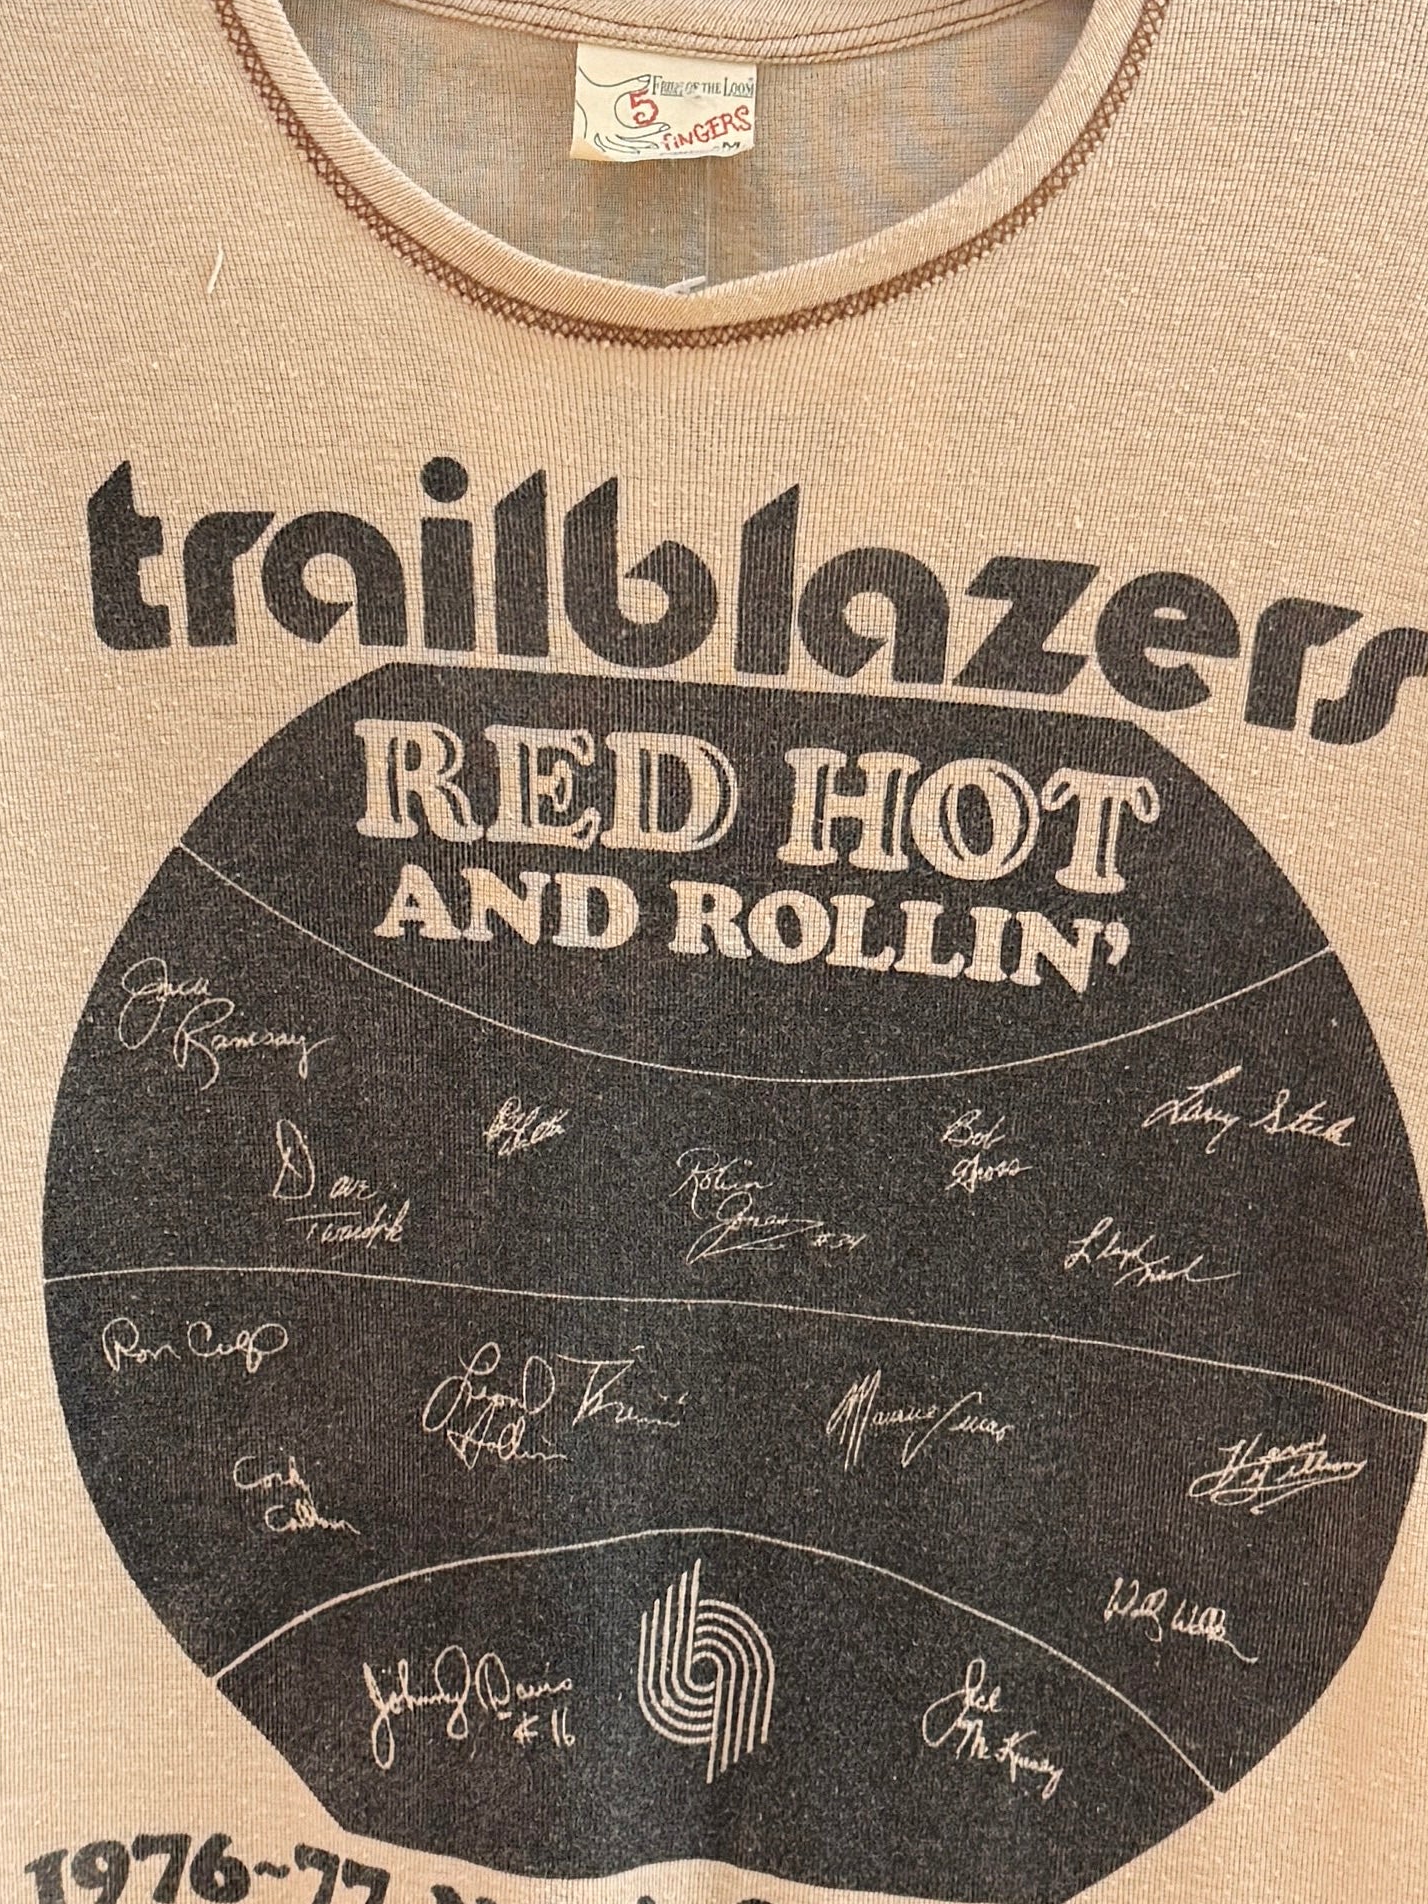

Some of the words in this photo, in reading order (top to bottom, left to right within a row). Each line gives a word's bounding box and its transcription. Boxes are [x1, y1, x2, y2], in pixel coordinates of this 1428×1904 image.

[627, 89, 659, 127] 5
[701, 82, 721, 94] THE
[723, 76, 754, 98] LOOM
[355, 716, 738, 854] RED
[777, 743, 1160, 895] HOT
[374, 865, 641, 956] AND
[668, 879, 1132, 994] ROLLIN'
